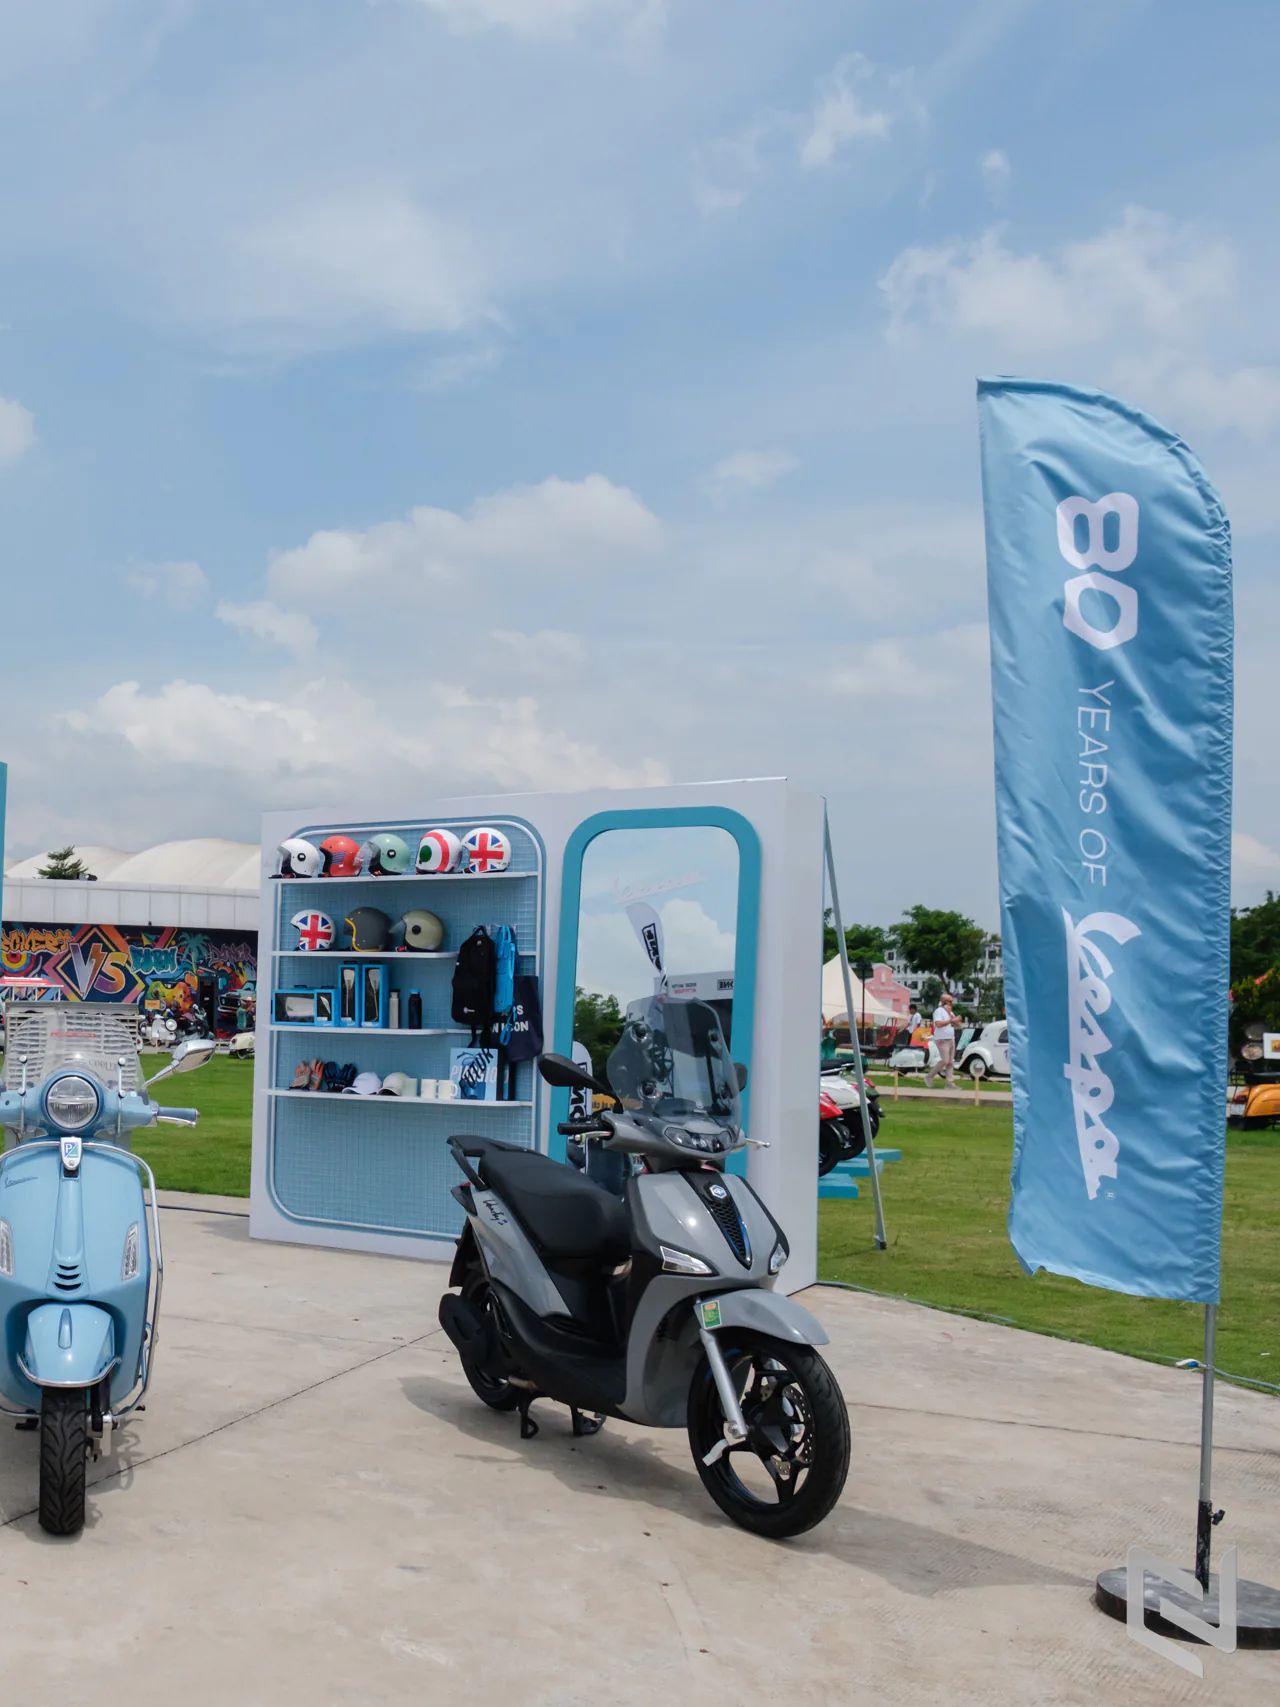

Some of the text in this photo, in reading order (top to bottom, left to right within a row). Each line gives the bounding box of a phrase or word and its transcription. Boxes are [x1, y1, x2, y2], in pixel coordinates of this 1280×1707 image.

[1056, 492, 1143, 1201] 80 YEARS OF Vespa
